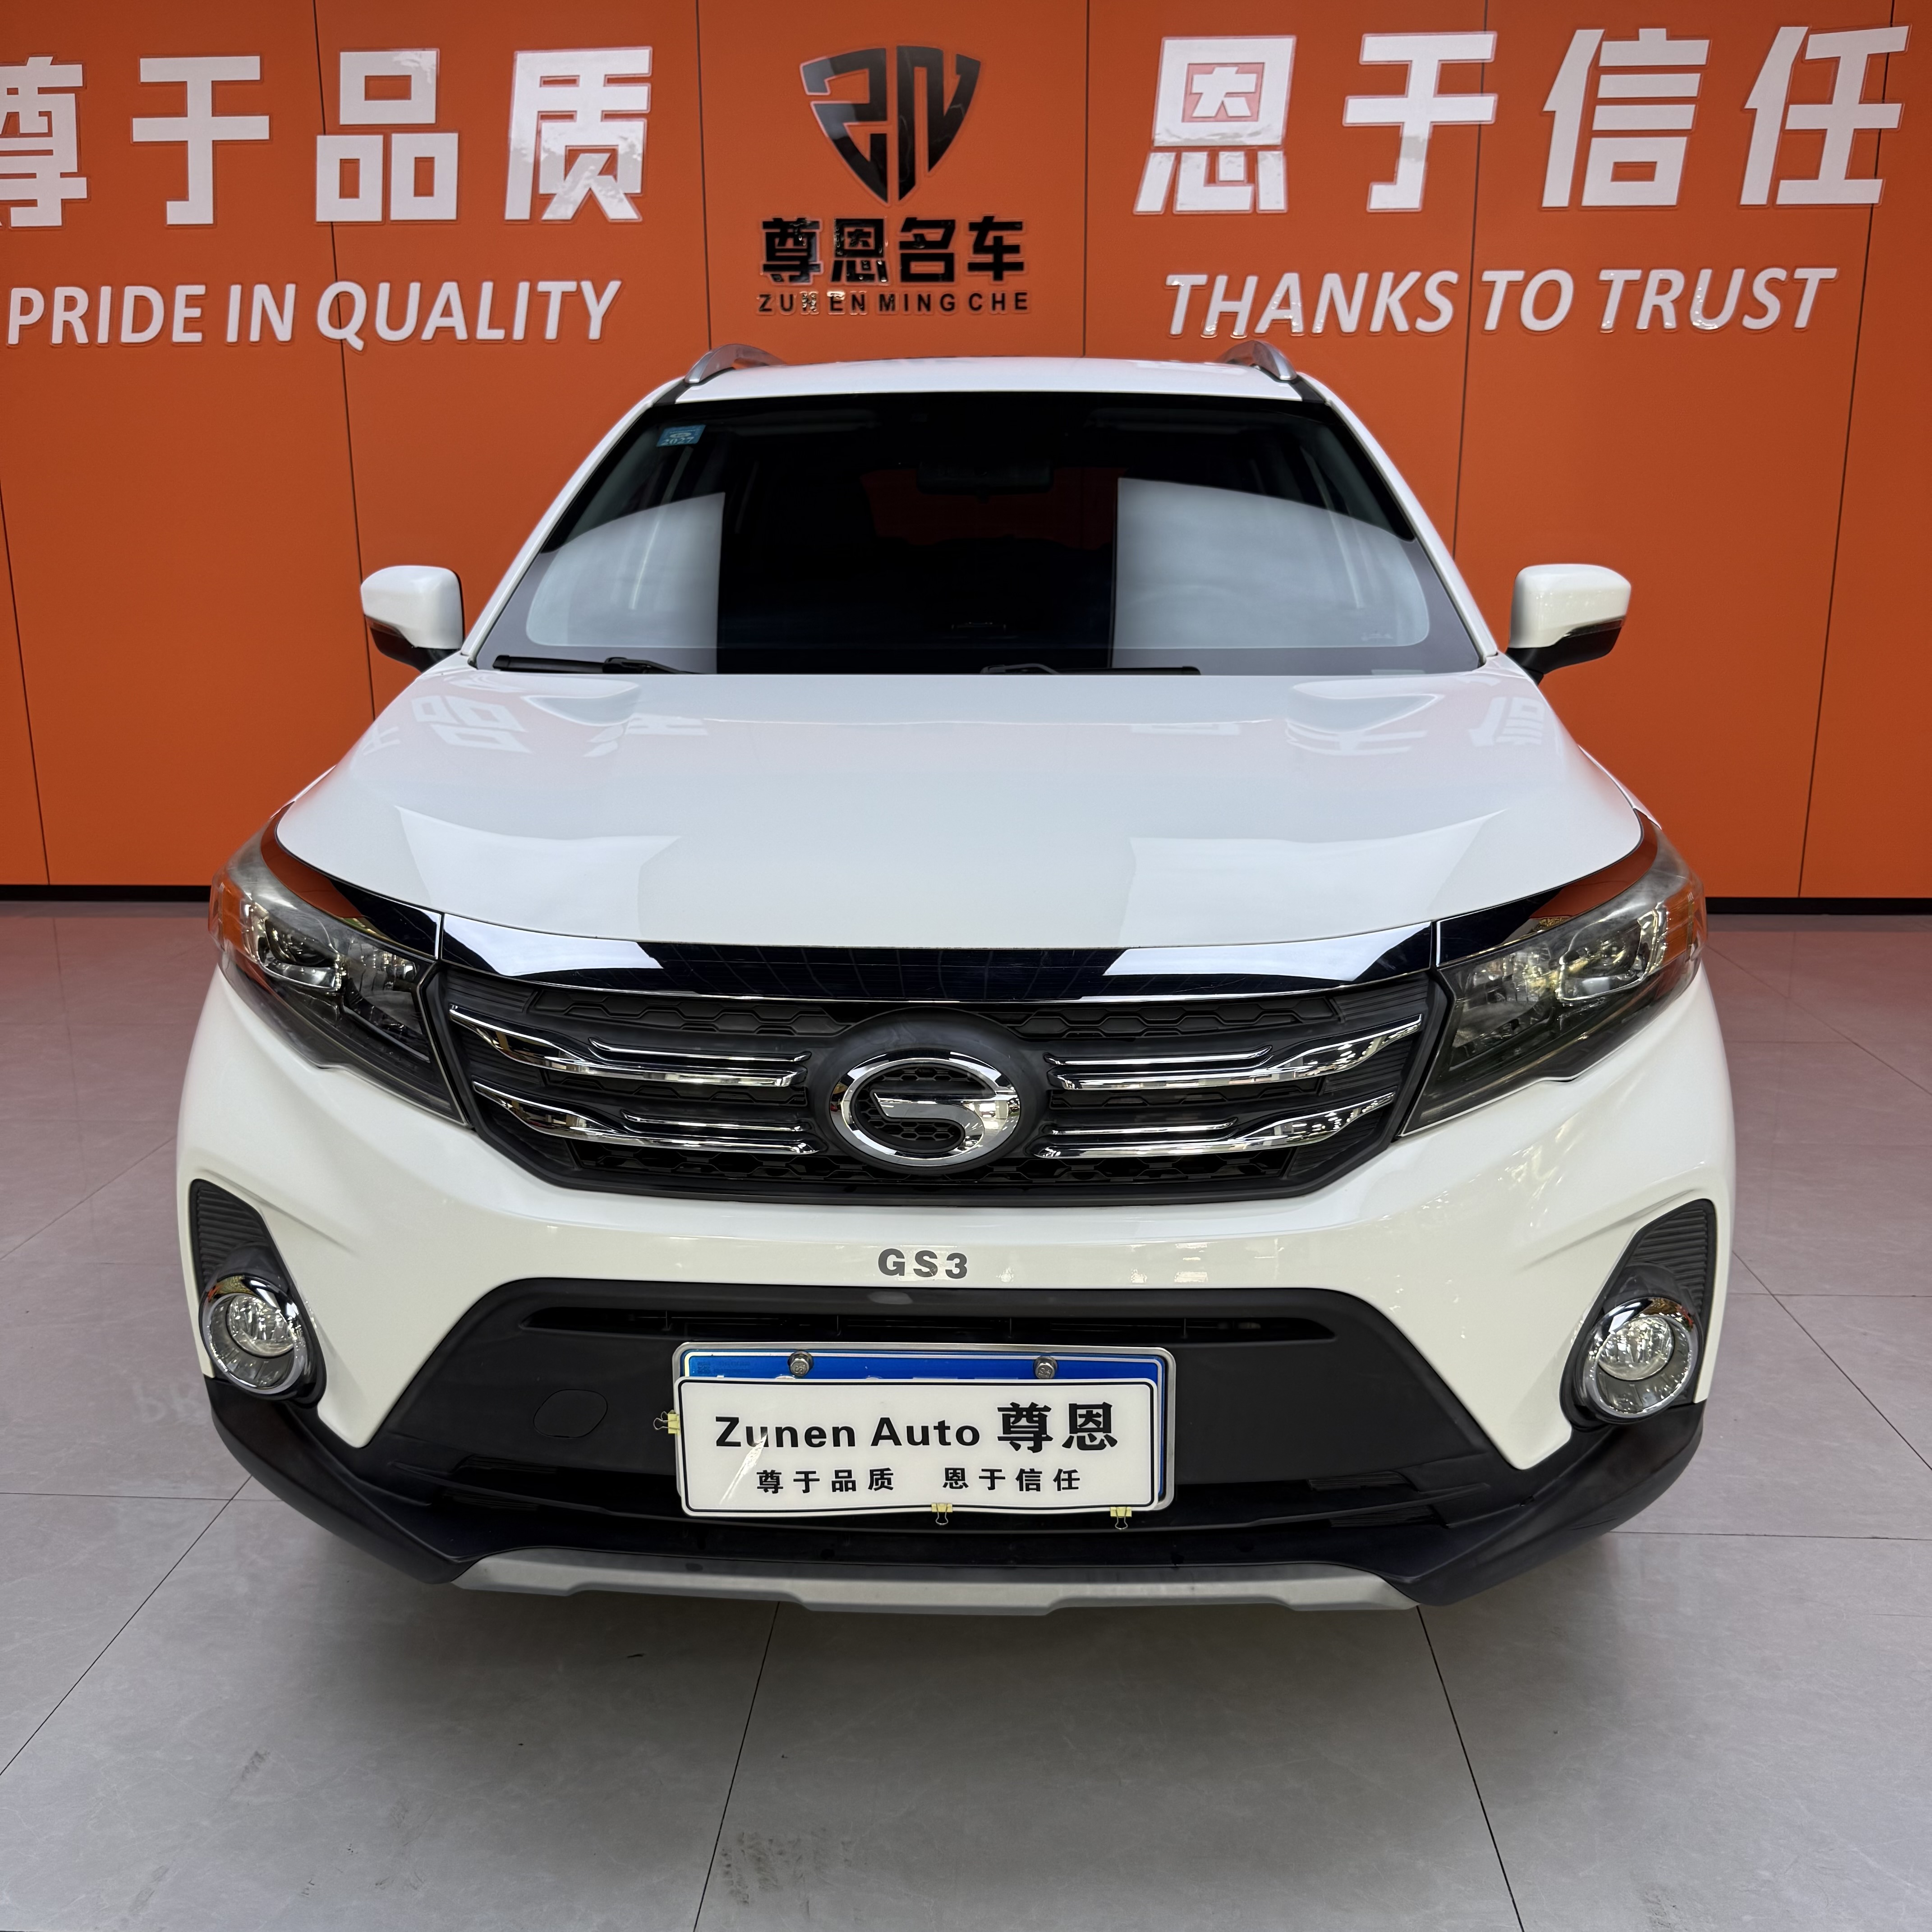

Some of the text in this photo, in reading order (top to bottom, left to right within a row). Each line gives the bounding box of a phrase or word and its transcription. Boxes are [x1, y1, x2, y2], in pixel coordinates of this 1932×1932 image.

[0, 46, 652, 227] 尊于品质
[1134, 25, 1909, 212] 恩于信任
[762, 215, 1025, 283] 尊恩名车
[8, 280, 621, 351] PRIDE IN QUALITY
[1165, 267, 1837, 339] THANKS TO TRUST
[661, 437, 694, 446] 2027
[878, 1248, 967, 1279] GS3
[715, 1402, 1118, 1454] Zunen Auto 尊恩
[756, 1467, 1081, 1495] 尊于品质 恩于信任
